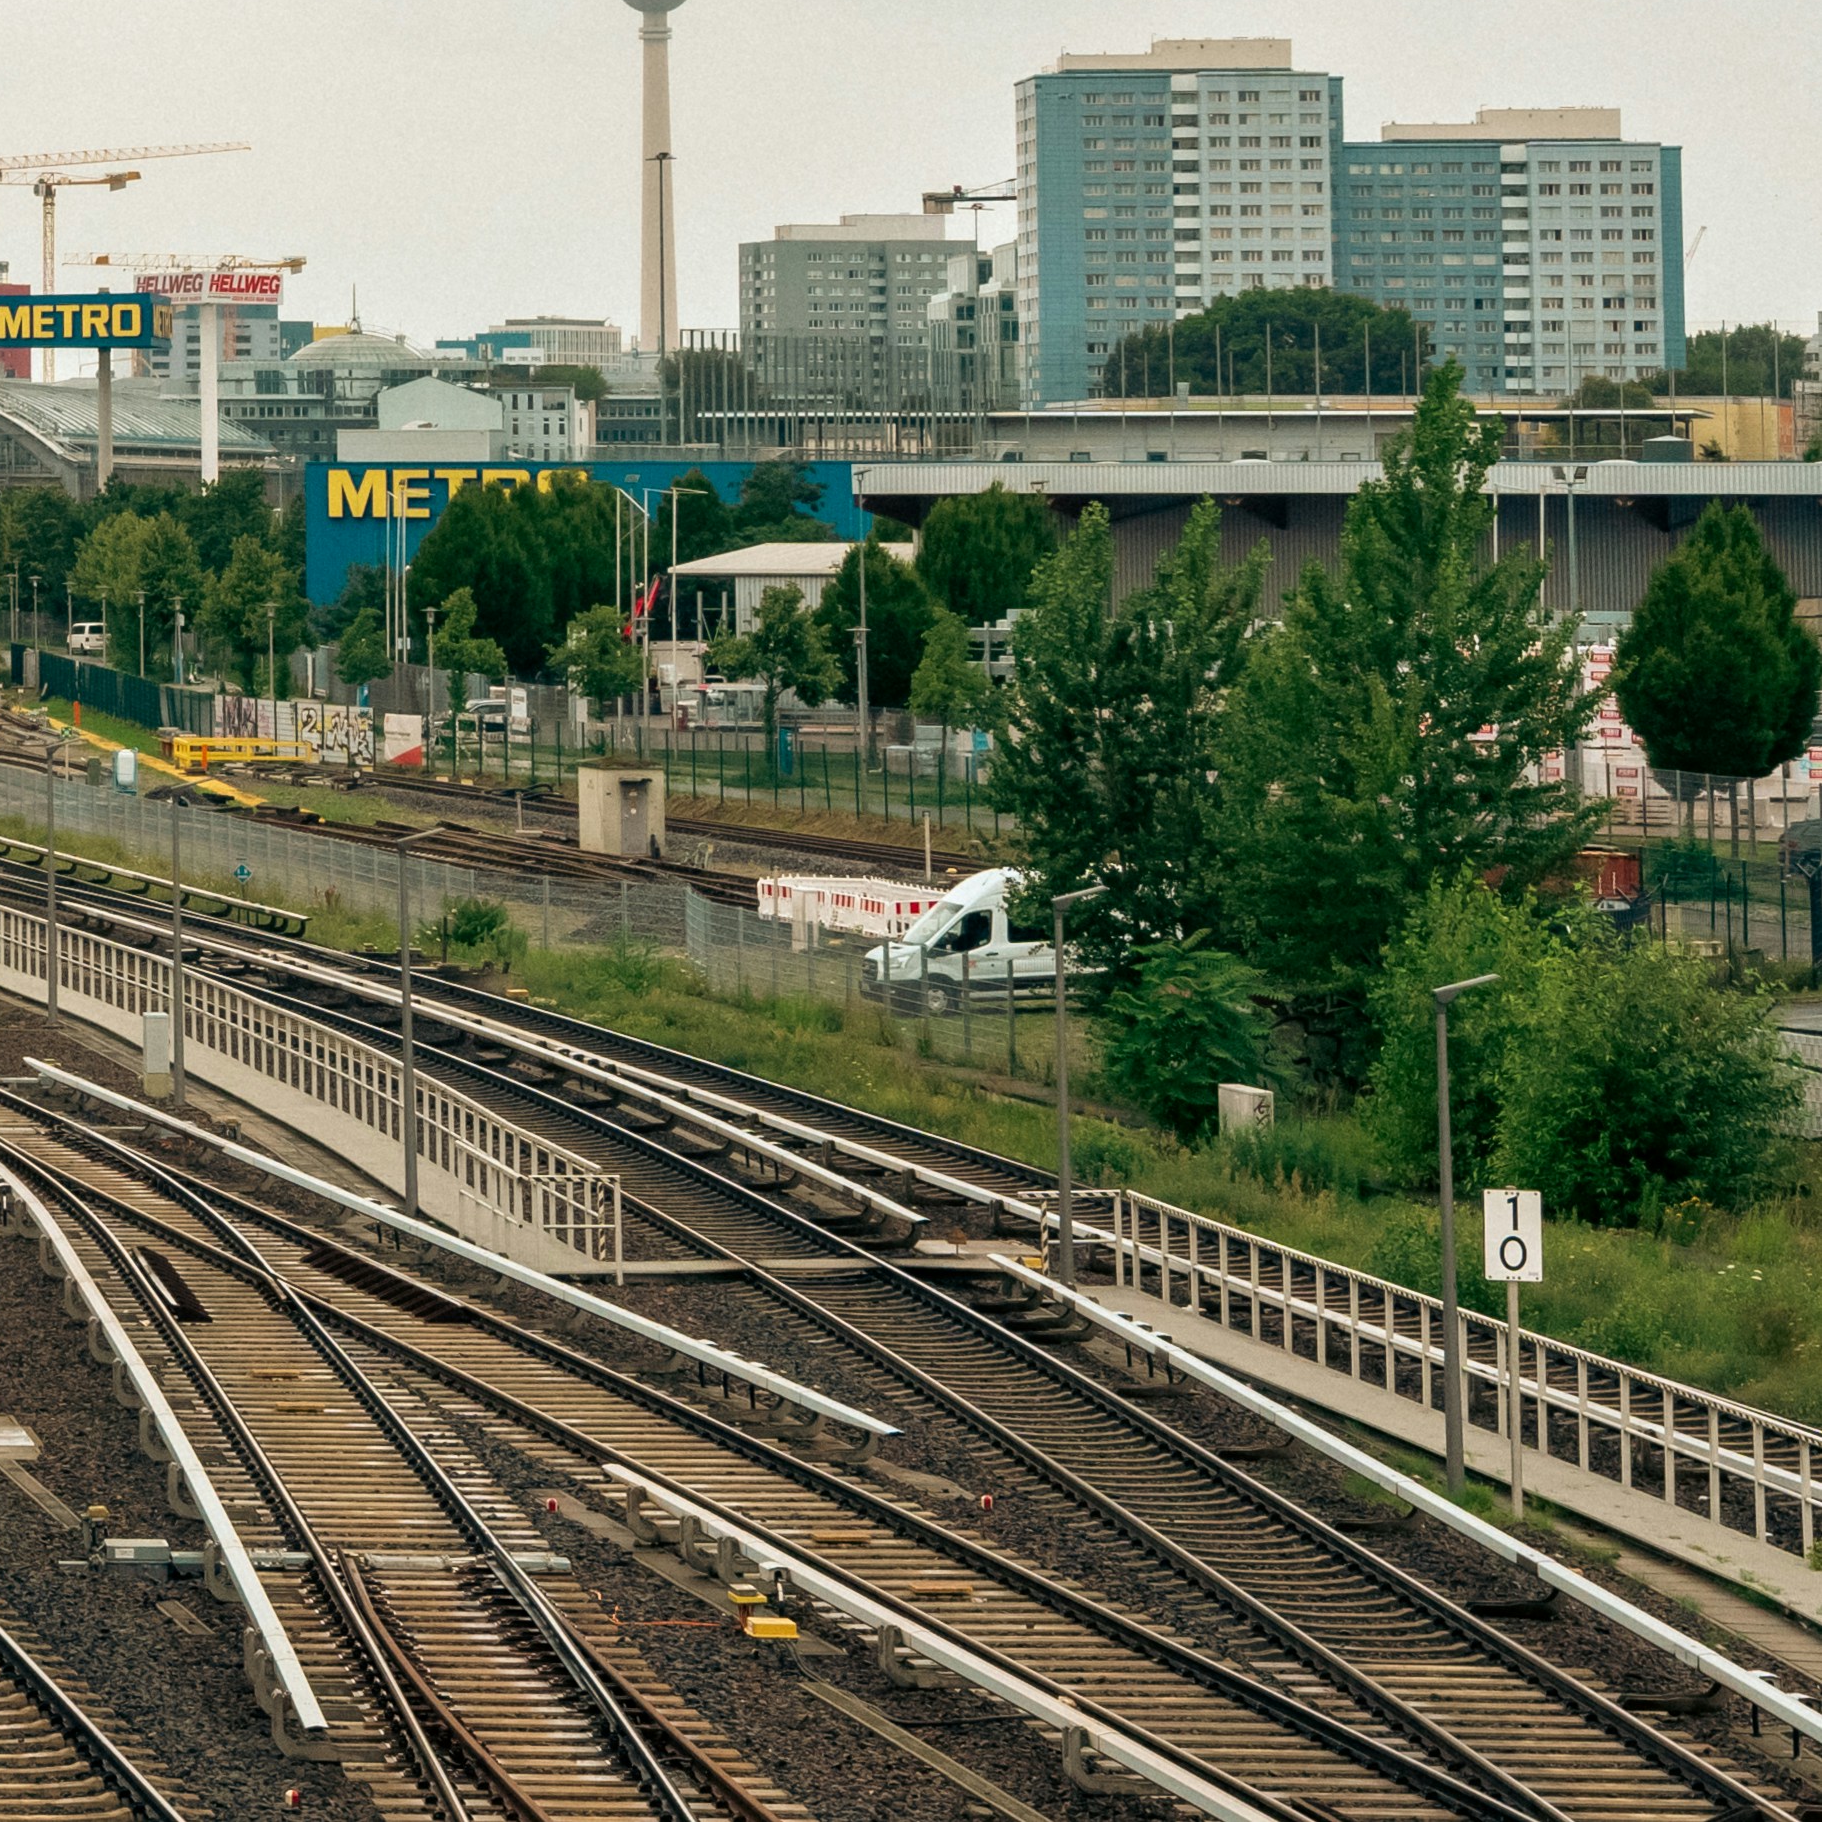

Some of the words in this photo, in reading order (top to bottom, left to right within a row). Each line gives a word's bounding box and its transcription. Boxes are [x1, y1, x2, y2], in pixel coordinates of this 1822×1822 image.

[136, 274, 204, 294] HELLWEG
[209, 274, 281, 294] HELLWEG
[1507, 1196, 1518, 1231] 1
[1499, 1236, 1527, 1271] 0
